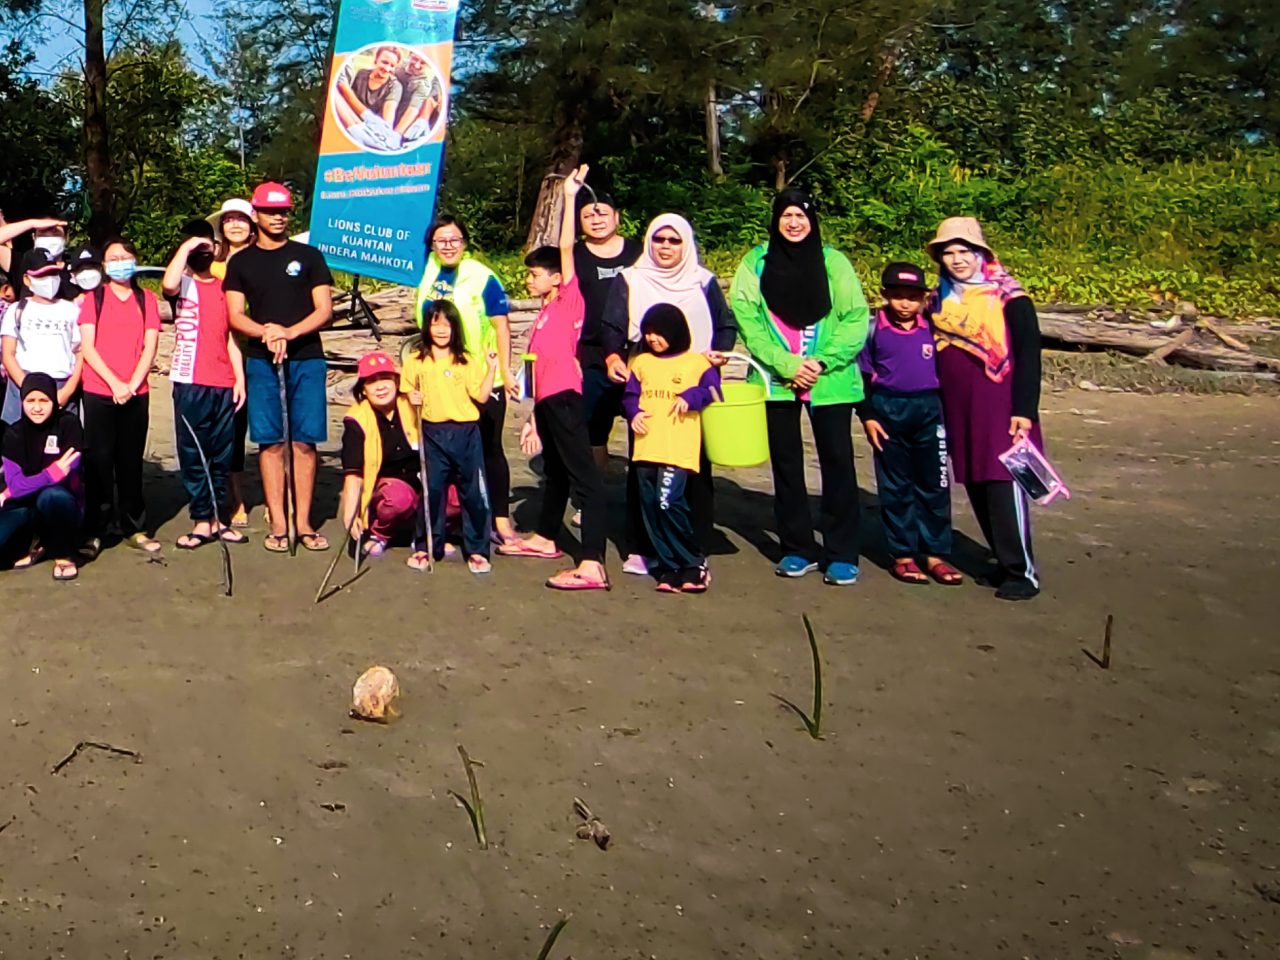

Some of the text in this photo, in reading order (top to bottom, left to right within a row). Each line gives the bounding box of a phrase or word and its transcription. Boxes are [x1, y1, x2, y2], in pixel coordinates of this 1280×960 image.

[328, 218, 411, 240] LIONS CLUB OF
[318, 243, 414, 271] INDERA MAHKOTA
[342, 234, 393, 253] KUANTAN
[176, 297, 198, 342] POLO
[180, 344, 194, 377] QUALITY
